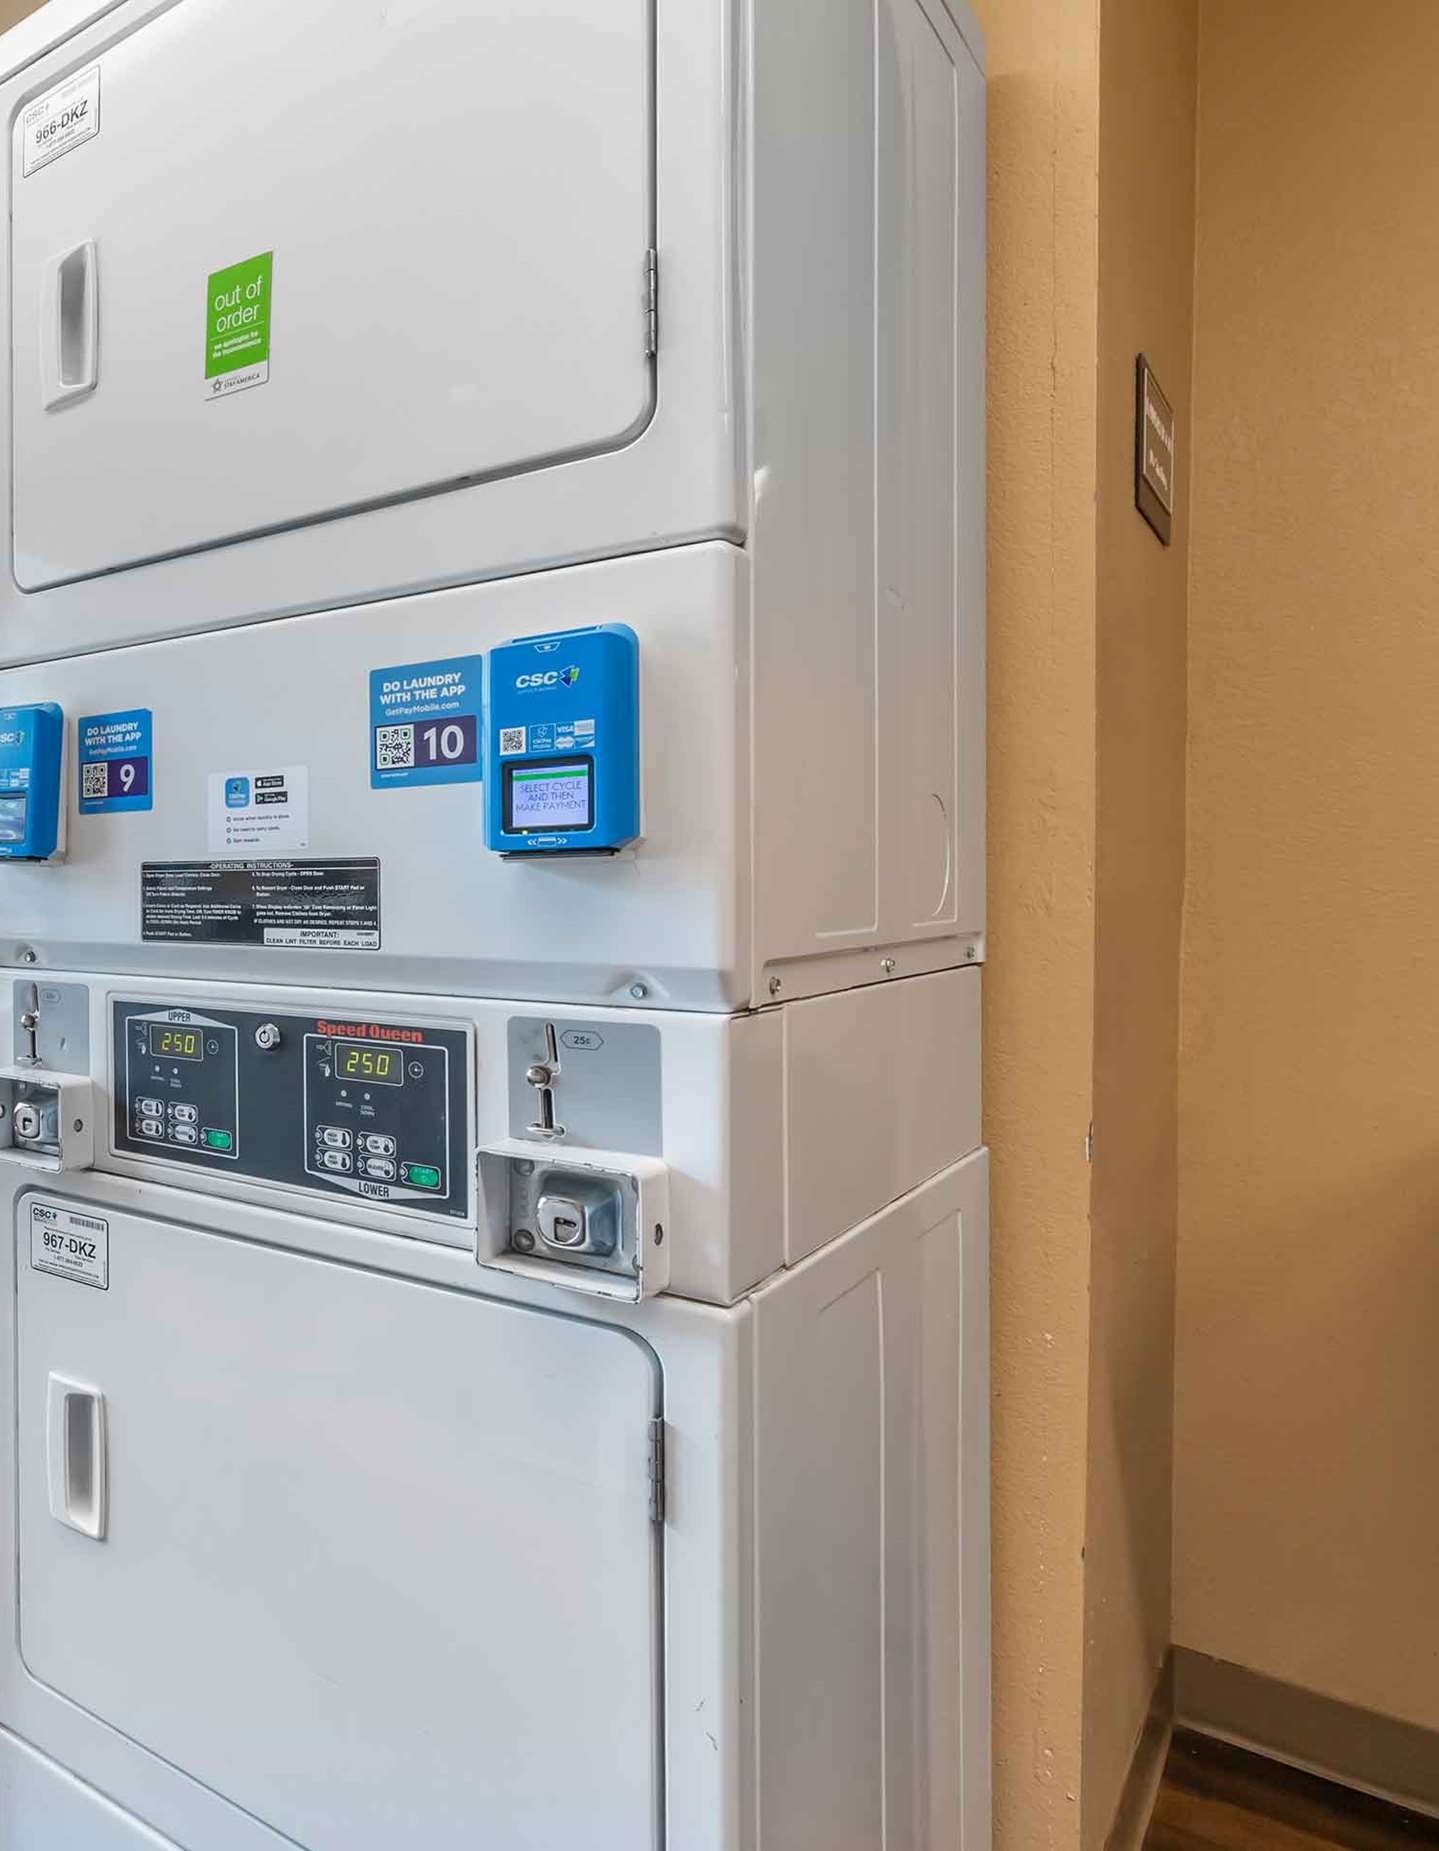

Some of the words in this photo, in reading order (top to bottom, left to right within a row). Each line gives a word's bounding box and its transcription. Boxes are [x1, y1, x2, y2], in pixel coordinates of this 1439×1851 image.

[36, 100, 88, 144] 966-DKZ
[215, 285, 241, 312] out
[246, 274, 263, 299] of
[216, 304, 260, 333] order
[383, 681, 400, 693] DO
[404, 672, 462, 689] LAUNDRY
[516, 671, 558, 688] CSC
[380, 692, 411, 705] WITH
[413, 688, 437, 701] THE
[440, 685, 466, 698] APP
[385, 701, 460, 717] GetPayMobile.com
[87, 727, 99, 737] DO
[100, 722, 138, 734] LAUNDRY
[85, 735, 107, 746] WITH
[108, 733, 123, 743] THE
[125, 732, 142, 742] APP
[423, 725, 464, 760] 10
[120, 764, 135, 793] 9
[519, 782, 550, 793] SELECT
[552, 780, 582, 791] CYCLE
[528, 793, 548, 802] AND
[551, 791, 574, 800] THEN
[516, 802, 541, 812] MAKE
[543, 800, 586, 811] PAYMENT
[300, 930, 339, 938] IMPORTANT:
[168, 1011, 191, 1022] UPPER
[316, 1020, 366, 1039] Speed
[369, 1024, 423, 1043] Queen
[161, 1032, 195, 1054] 250
[346, 1051, 390, 1076] 250
[358, 1182, 389, 1197] LOWER
[33, 1207, 51, 1219] CSC
[43, 1232, 96, 1259] 967-DKZ
